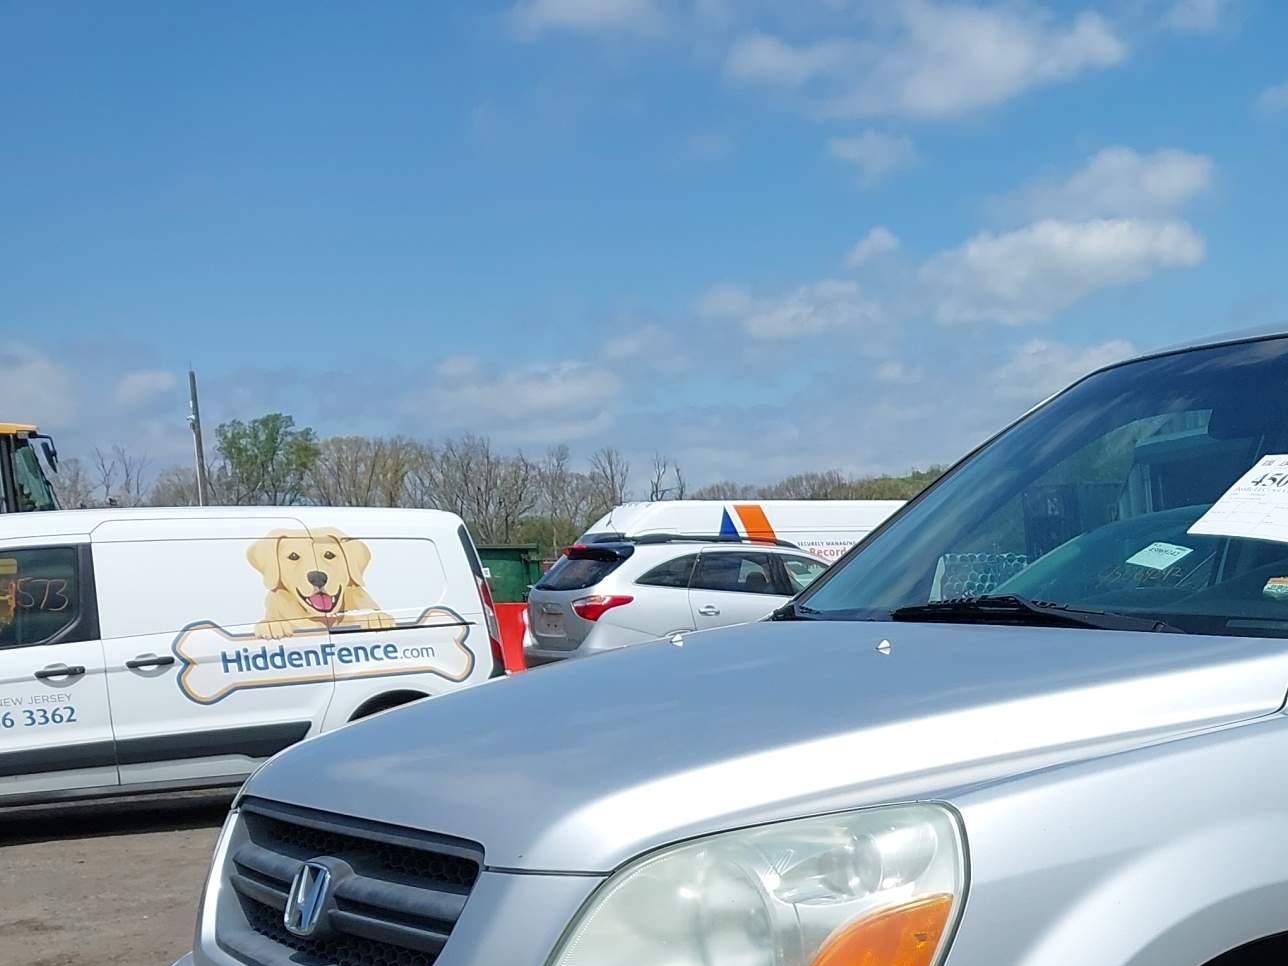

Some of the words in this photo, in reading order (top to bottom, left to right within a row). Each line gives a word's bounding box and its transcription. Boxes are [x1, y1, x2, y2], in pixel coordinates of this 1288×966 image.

[221, 643, 435, 673] HiddenFence.com
[28, 693, 73, 705] JERSEY
[22, 706, 77, 727] 3362
